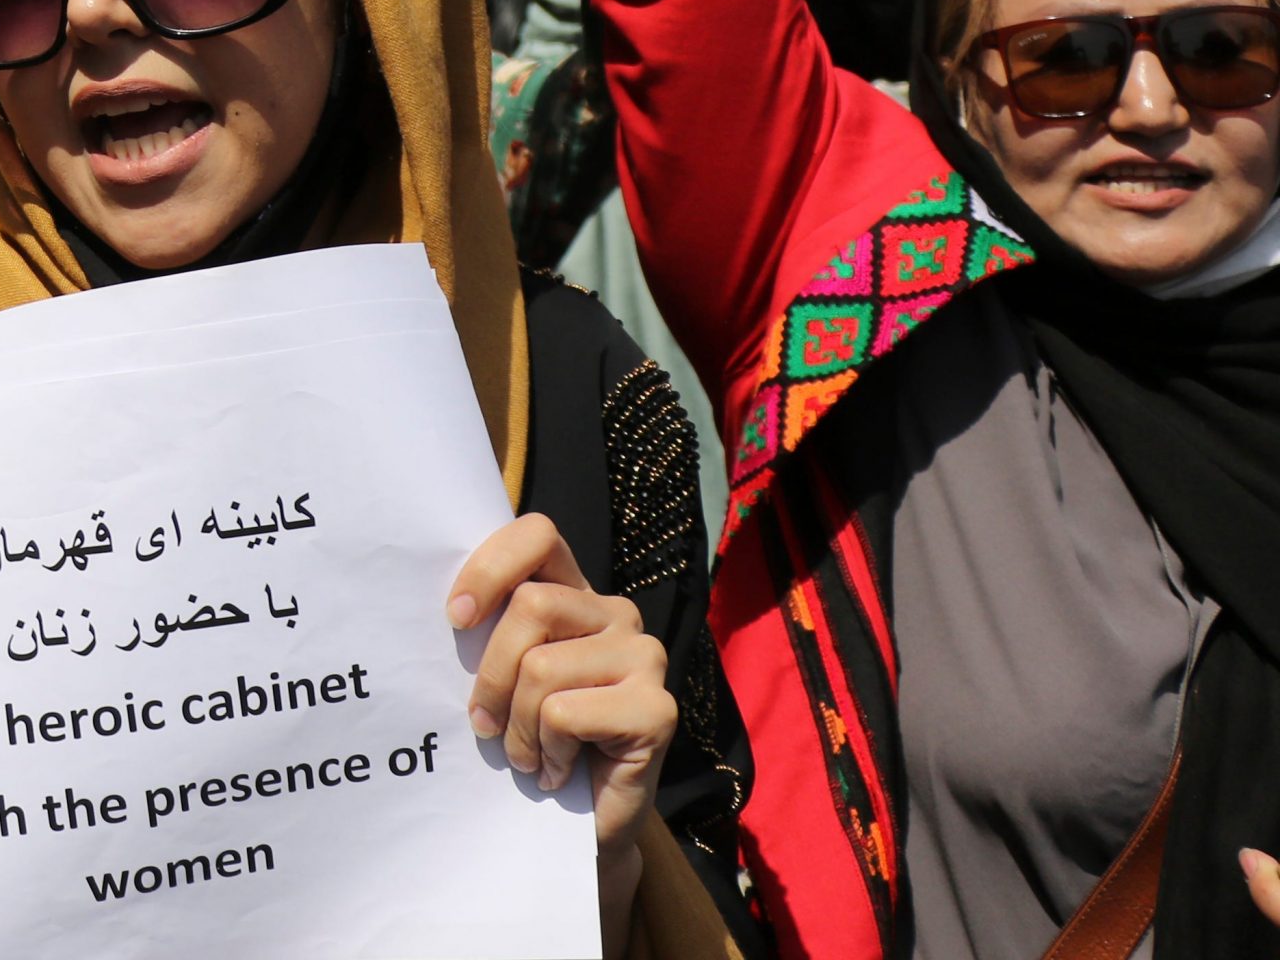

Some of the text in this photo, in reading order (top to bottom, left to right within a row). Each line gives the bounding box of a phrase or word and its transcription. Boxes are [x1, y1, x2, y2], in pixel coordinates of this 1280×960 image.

[136, 510, 181, 562] ای
[201, 493, 316, 549] کابینه
[8, 584, 299, 661] با حضور زنان
[5, 692, 165, 745] heroic
[182, 664, 370, 724] cabinet
[42, 788, 127, 831] the
[145, 754, 370, 828] presence
[389, 732, 437, 776] of
[86, 844, 274, 902] women
